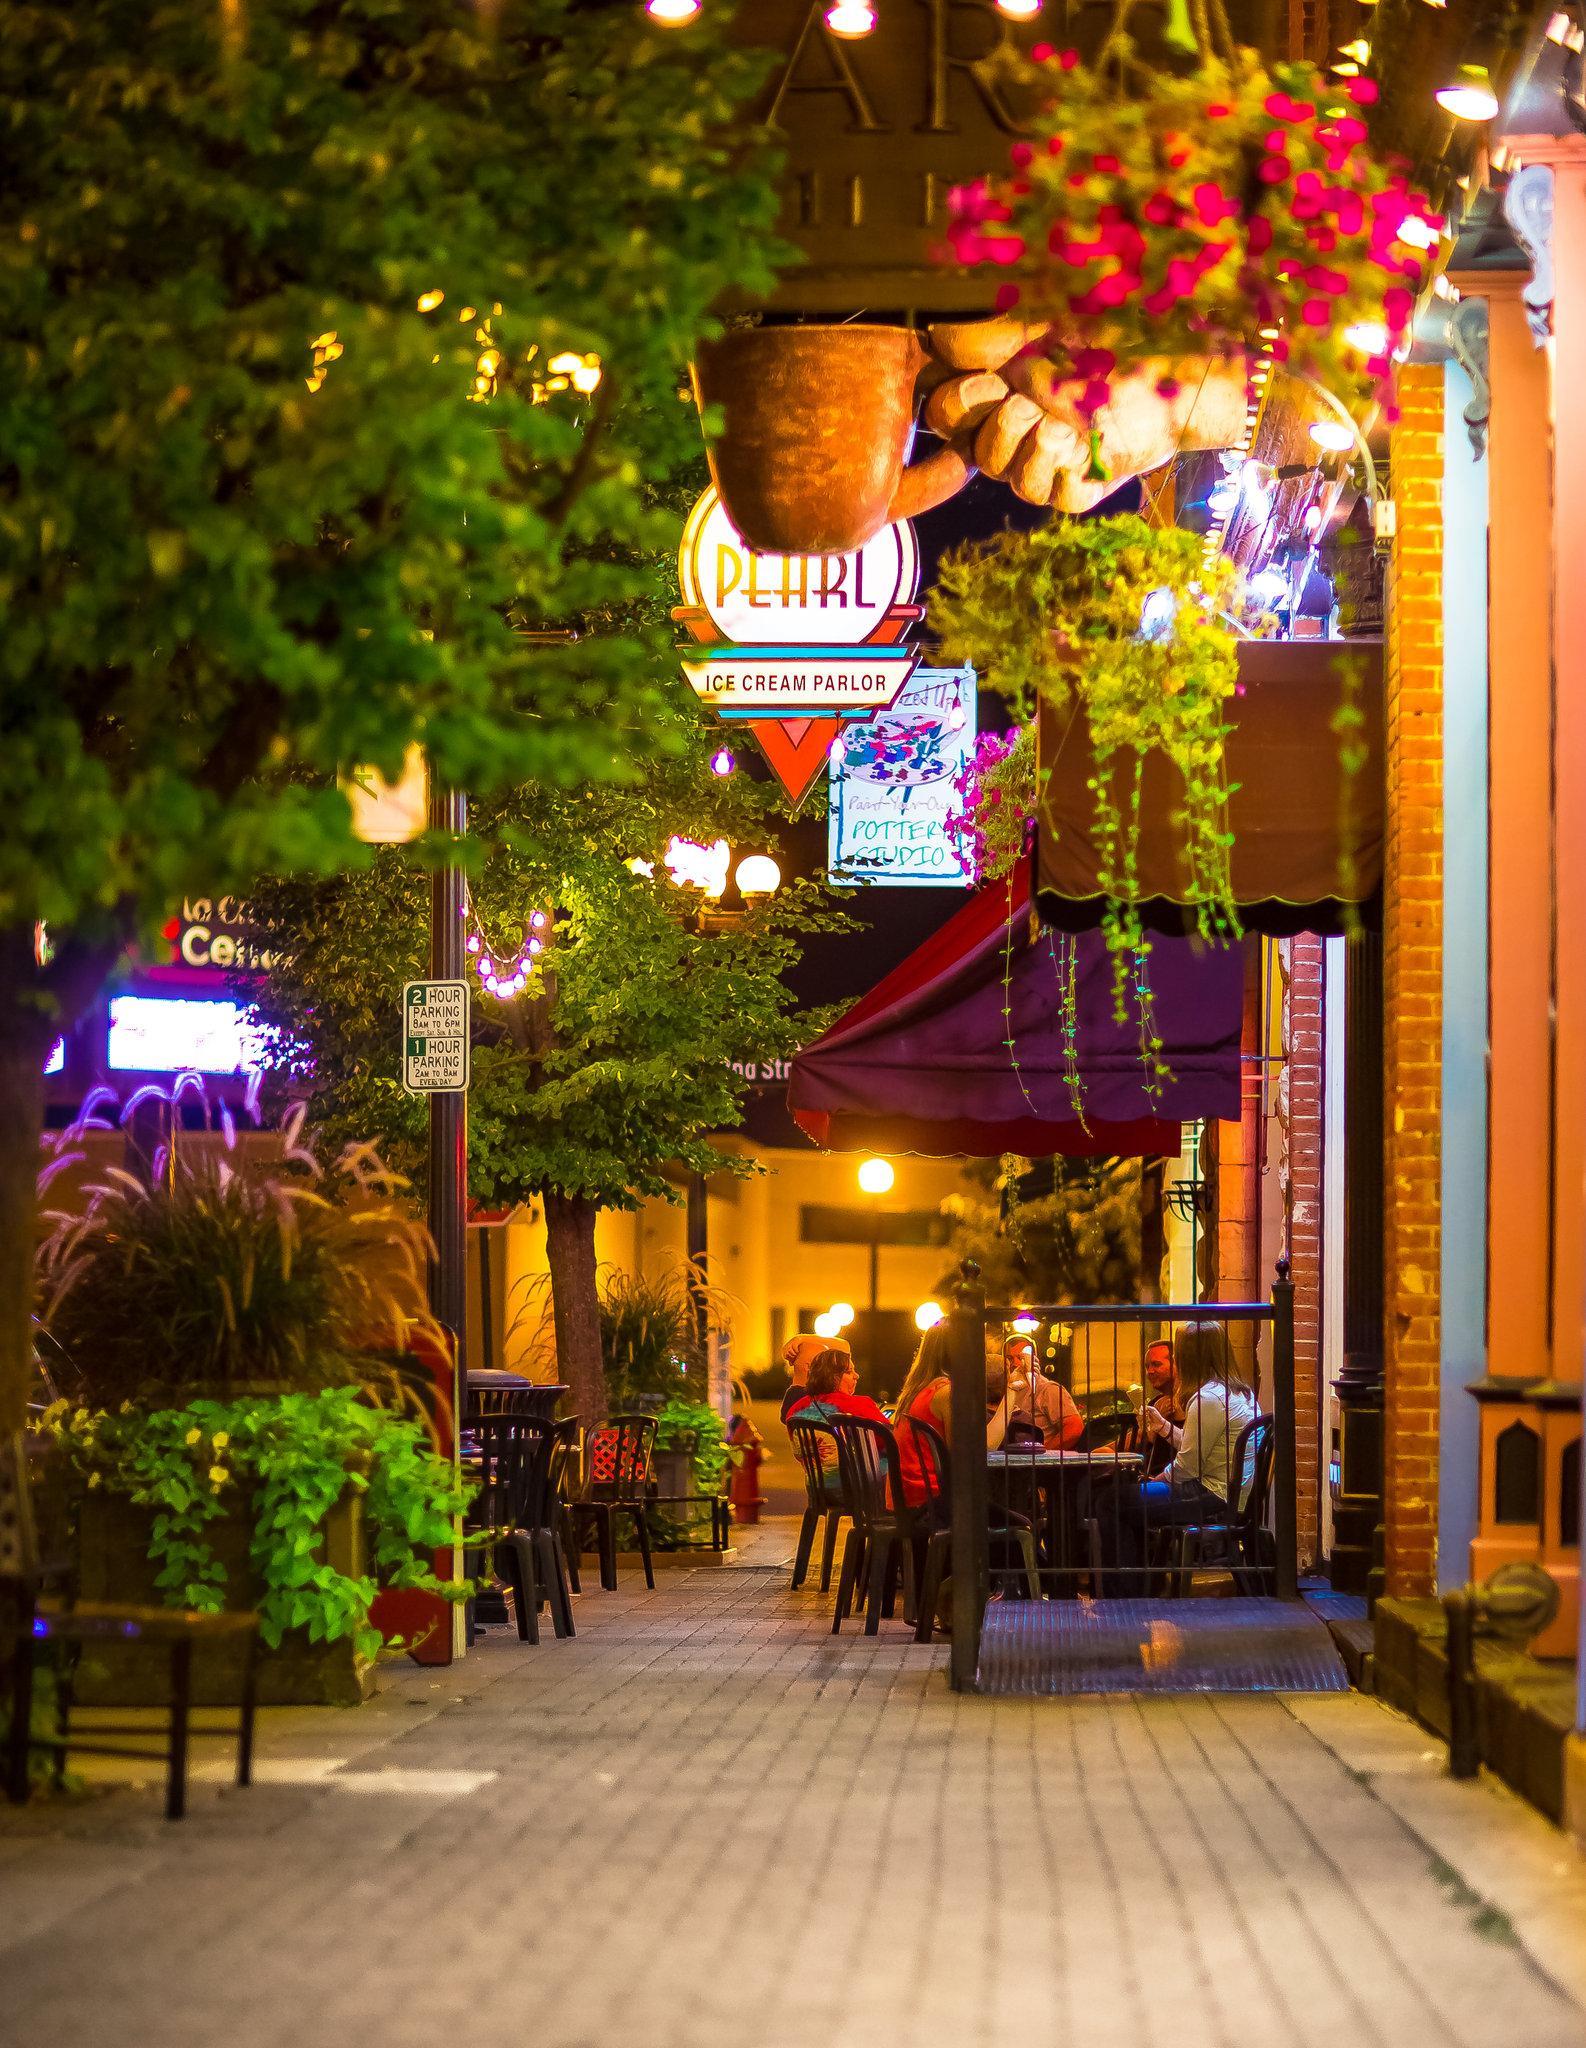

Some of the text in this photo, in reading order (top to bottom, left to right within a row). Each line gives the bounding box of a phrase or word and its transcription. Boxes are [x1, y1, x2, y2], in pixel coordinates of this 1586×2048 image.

[716, 543, 876, 608] PEARL
[706, 675, 886, 691] ICE CREAM PARLOR
[412, 989, 460, 1004] 2 HOUR
[413, 1006, 460, 1018] PARKING
[413, 1018, 460, 1029] 8AM TO 6PM
[414, 1040, 460, 1054] 1 HOUR
[412, 1056, 460, 1069] PARKING
[761, 1058, 792, 1080] Str
[415, 1069, 429, 1078] 2AM
[443, 1068, 458, 1077] 8AM
